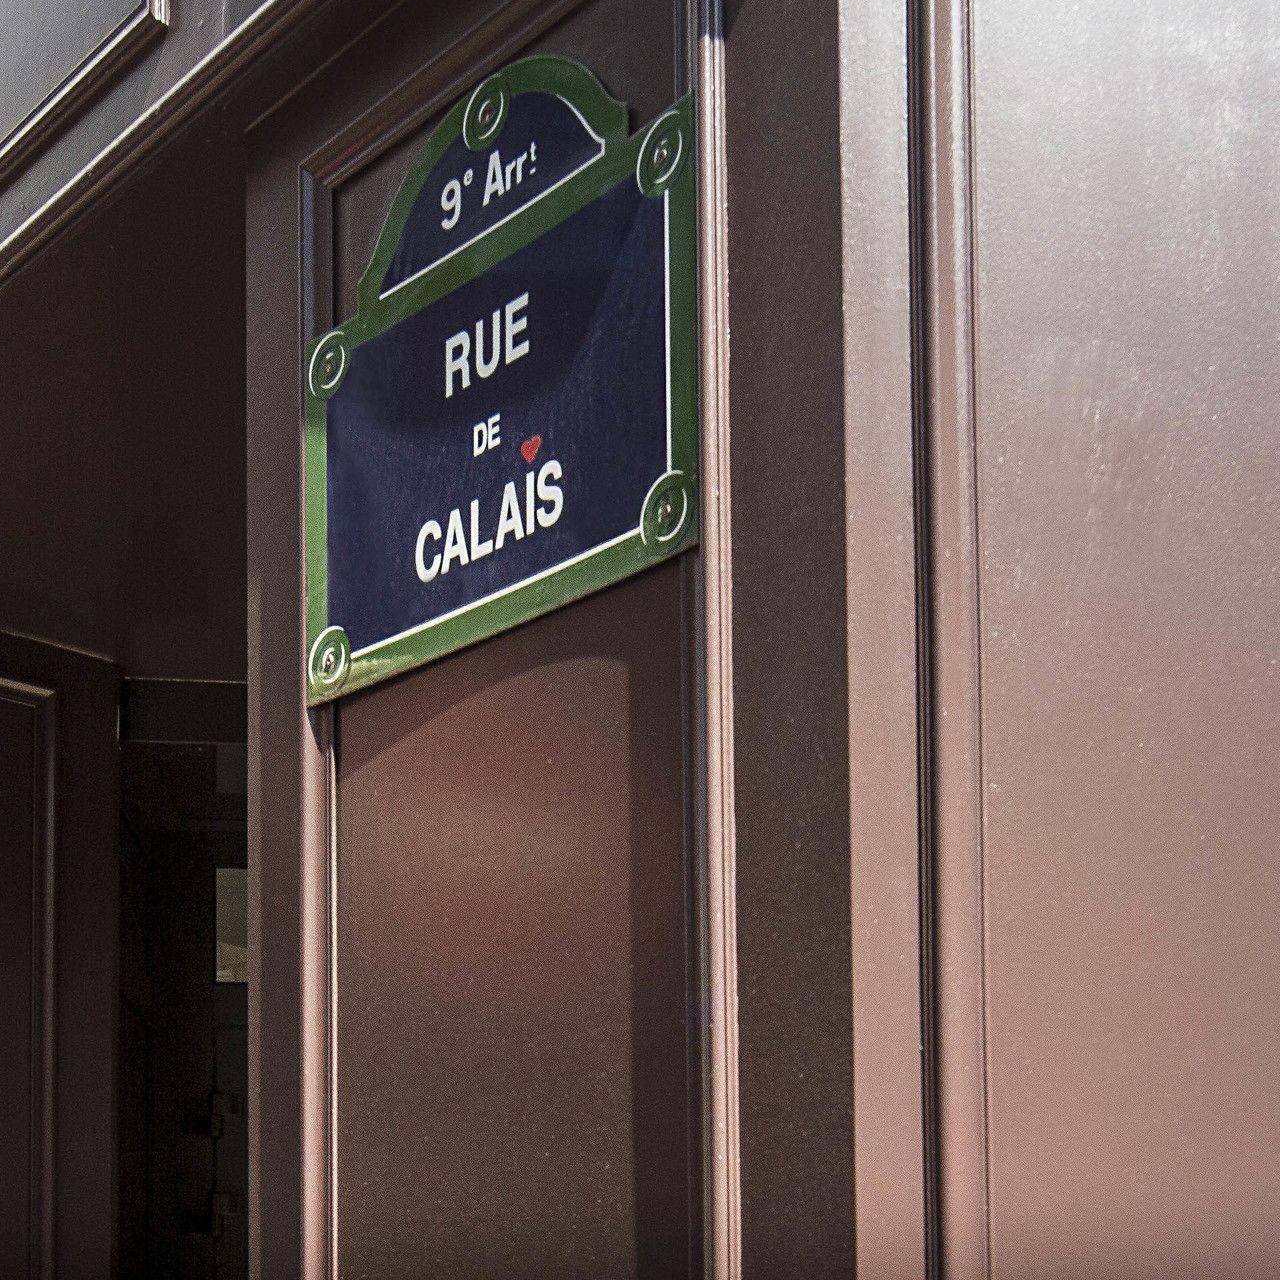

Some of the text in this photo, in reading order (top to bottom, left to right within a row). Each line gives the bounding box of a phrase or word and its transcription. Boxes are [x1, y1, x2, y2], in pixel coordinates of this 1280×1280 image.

[445, 292, 531, 398] RUE
[473, 414, 501, 458] DE
[415, 460, 565, 585] CALAIS
